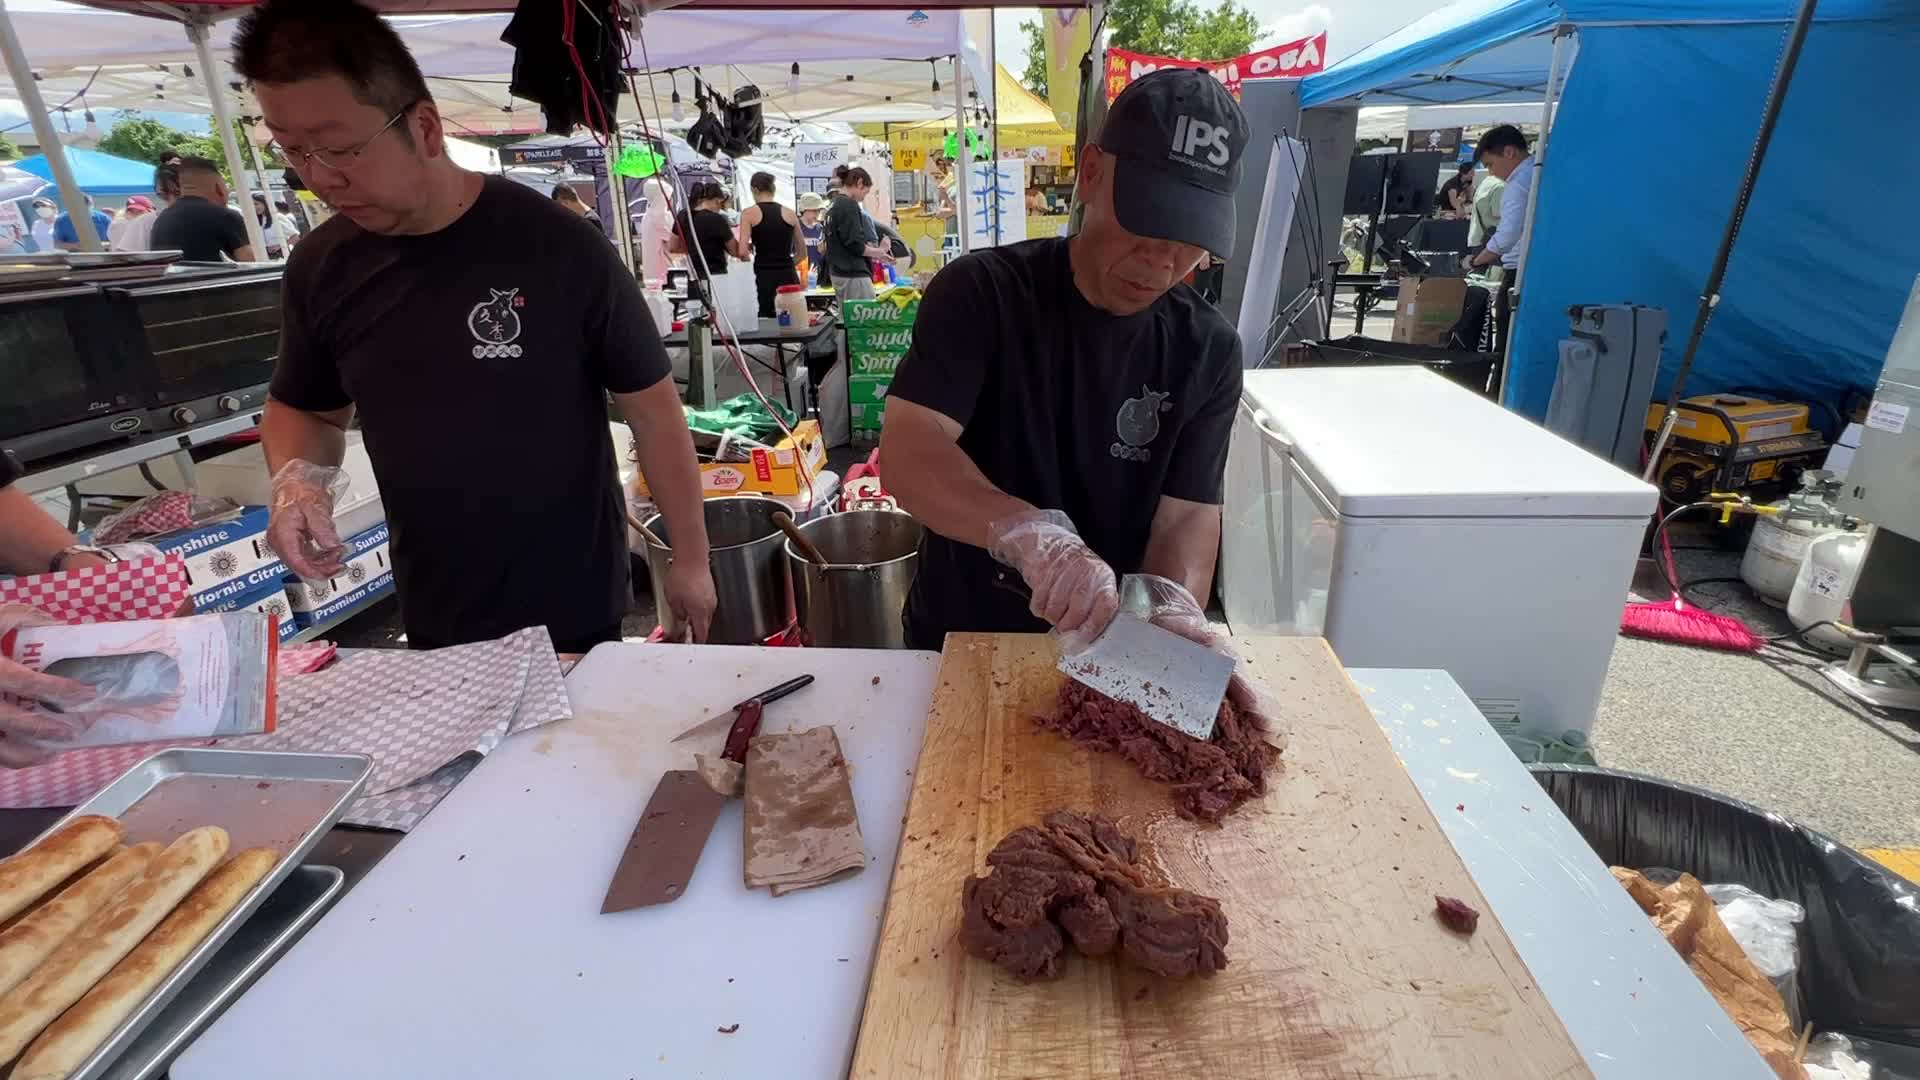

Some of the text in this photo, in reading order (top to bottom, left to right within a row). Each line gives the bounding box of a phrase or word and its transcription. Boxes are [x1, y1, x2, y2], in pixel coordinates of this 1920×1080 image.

[1171, 114, 1230, 166] IPS
[850, 302, 903, 324] Sprite
[858, 353, 902, 373] Sprit
[163, 530, 230, 555] nshine
[191, 582, 246, 608] ifornia
[248, 564, 288, 584] Citru
[315, 573, 394, 620] Premium Calif
